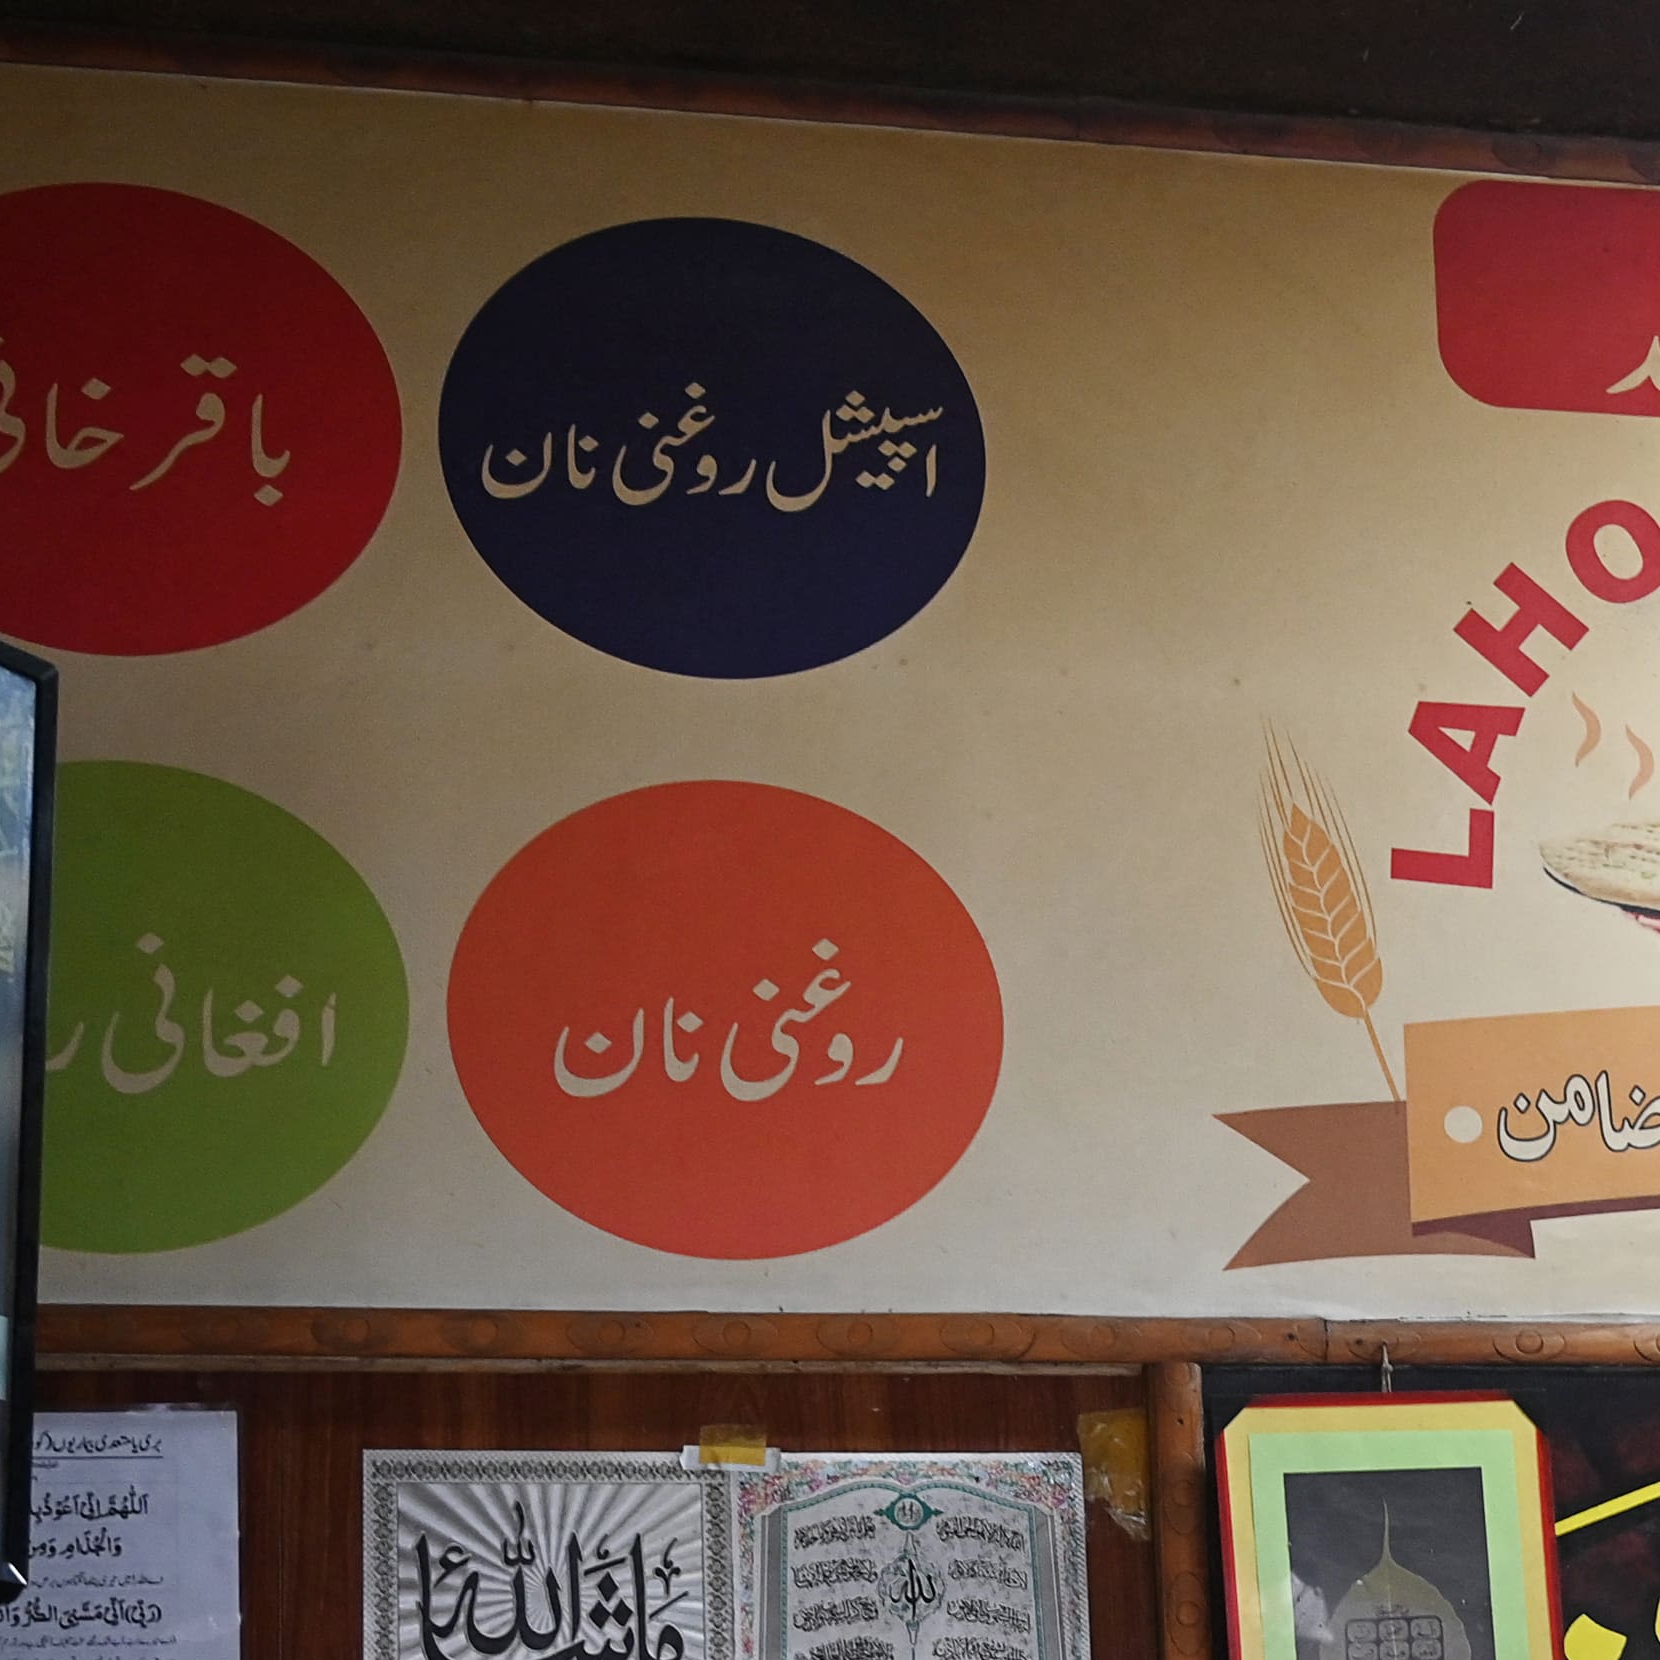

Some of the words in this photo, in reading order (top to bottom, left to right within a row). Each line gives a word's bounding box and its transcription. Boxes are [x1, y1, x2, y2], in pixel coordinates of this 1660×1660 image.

[481, 424, 599, 499] نان
[611, 382, 757, 506] روغنی
[766, 390, 943, 512] اسپیشل
[98, 932, 337, 1095] افغانی
[553, 996, 706, 1099] نان
[718, 937, 905, 1103] روغنی
